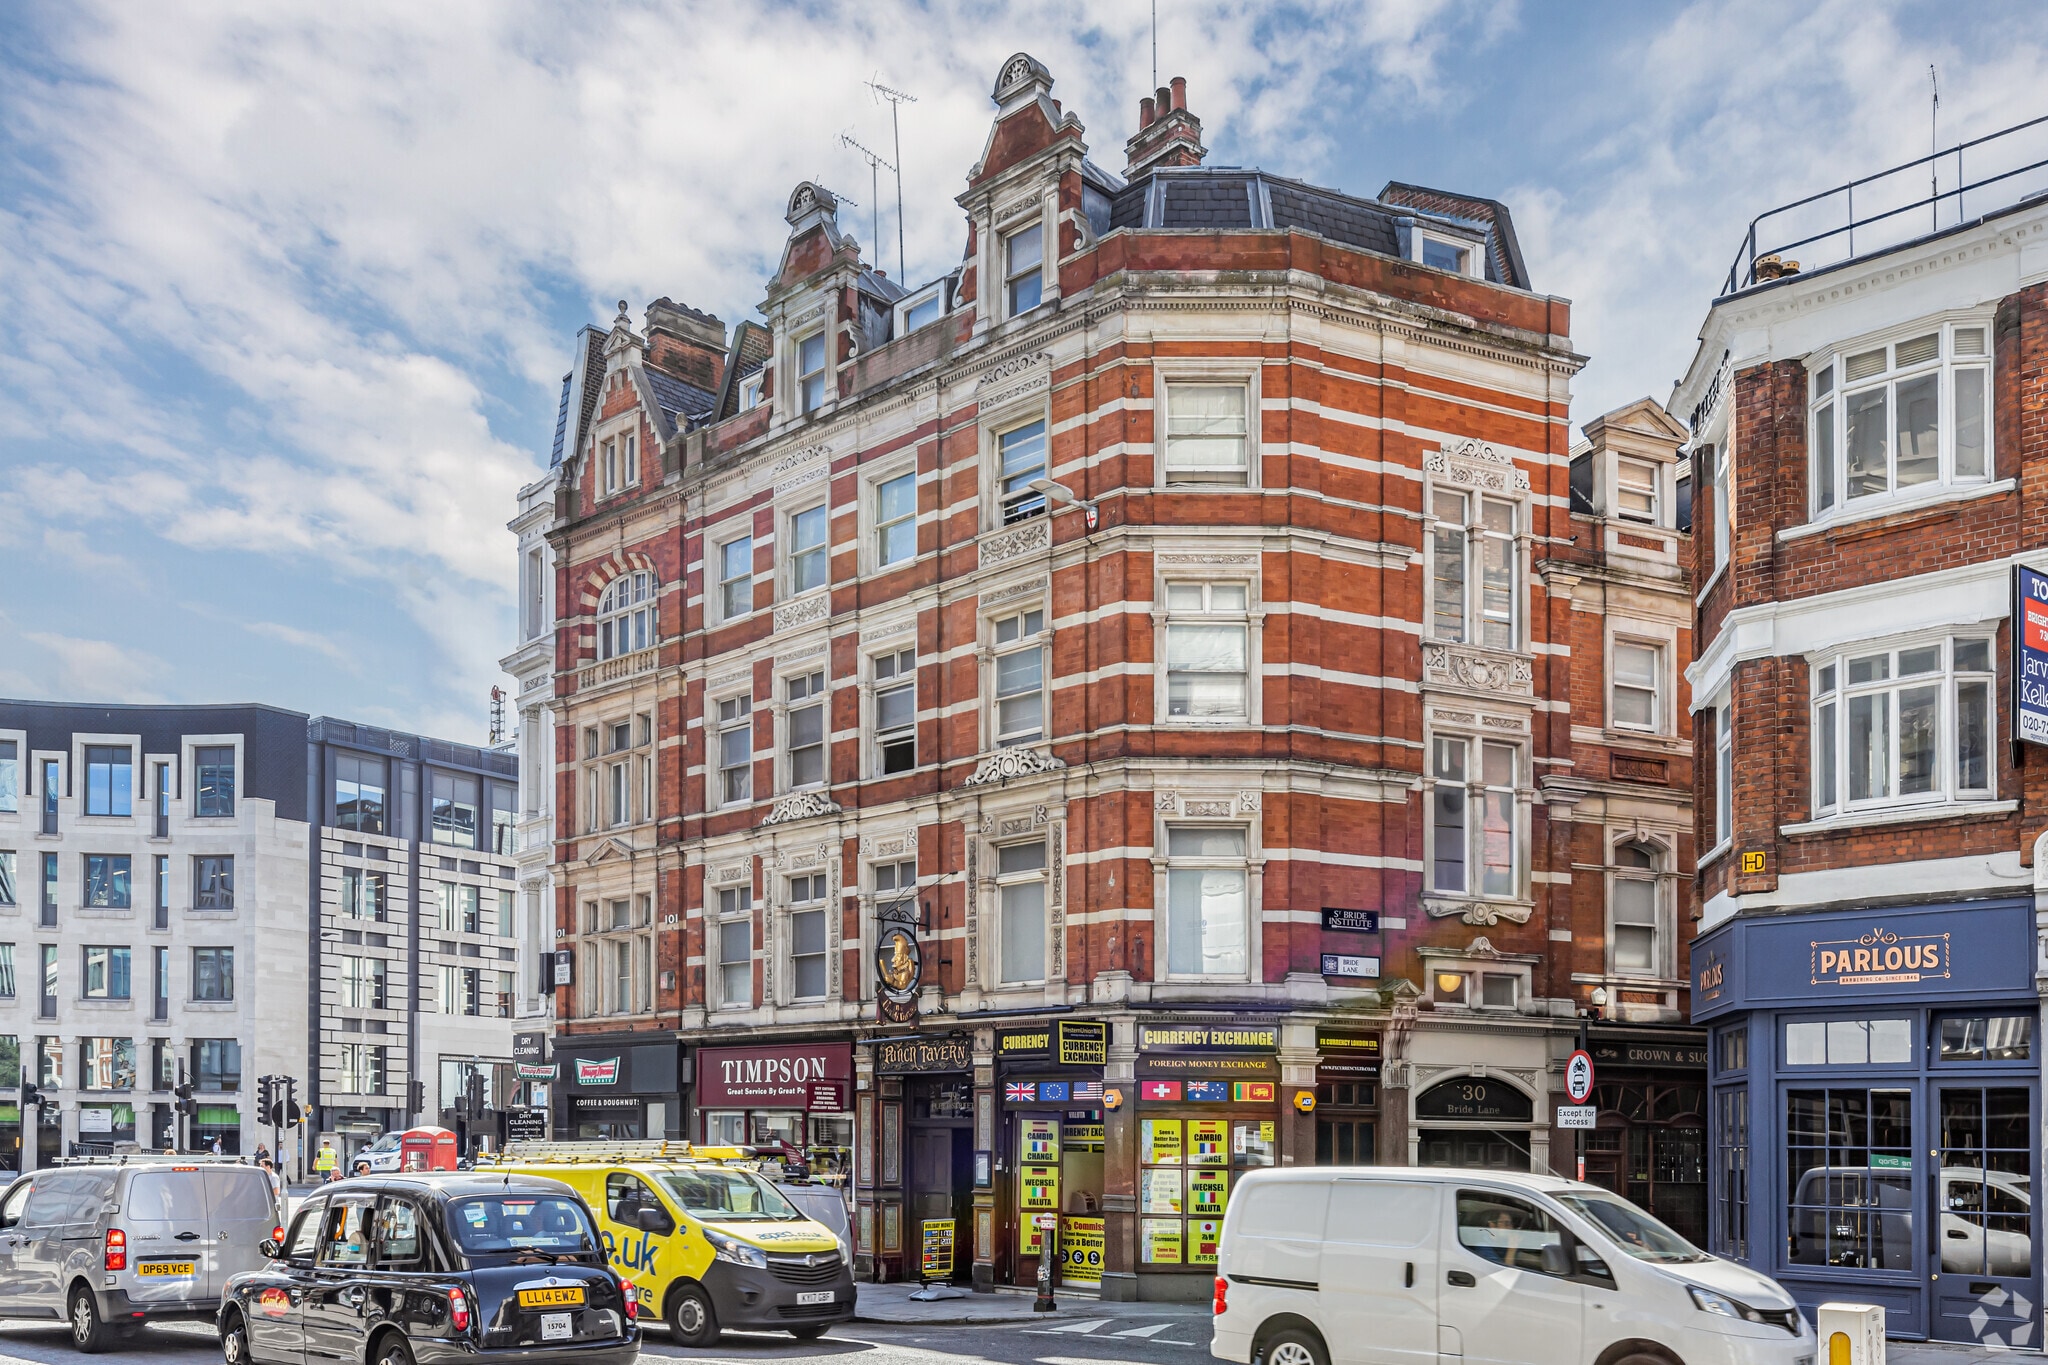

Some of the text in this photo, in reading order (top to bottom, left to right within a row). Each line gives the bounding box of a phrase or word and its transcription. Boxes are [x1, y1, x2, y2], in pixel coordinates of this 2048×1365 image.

[2031, 577, 2048, 600] TO
[2021, 649, 2048, 678] Jarv
[1343, 911, 1368, 920] BRIDE
[1328, 917, 1373, 928] INSTITUTE
[1820, 944, 1939, 974] PARLOUS
[1700, 964, 1723, 993] PARLOUS
[521, 1037, 533, 1045] DRY
[1002, 1034, 1050, 1050] CURRENCY
[1144, 1030, 1274, 1046] CURRENCY EXCHANGE
[1326, 1038, 1351, 1046] CURRENCY
[1062, 1040, 1105, 1052] CURRENCY
[514, 1047, 540, 1056] CLEANING
[1628, 1049, 1671, 1062] CROWN
[1675, 1051, 1684, 1062] &
[1063, 1051, 1104, 1063] EXCHANGE
[1149, 1060, 1267, 1069] FOREIGN MONEY EXCHANGE
[720, 1057, 827, 1084] TIMPSON
[727, 1086, 807, 1096] Great Service By Great Pe
[1462, 1085, 1486, 1101] 30
[1447, 1104, 1500, 1114] Bride Lane
[1558, 1109, 1595, 1118] Except for
[1027, 1132, 1054, 1140] CAMBIO
[1063, 1127, 1090, 1137] RRENCY
[1193, 1133, 1223, 1142] CAMBIO
[1027, 1152, 1054, 1161] CHANGE
[1194, 1154, 1223, 1163] CHANGE
[1024, 1178, 1055, 1187] WECHSEL
[1191, 1183, 1225, 1192] WECHSEL
[1027, 1198, 1052, 1206] VALUTA
[1195, 1204, 1222, 1212] VALUTA
[1063, 1238, 1075, 1246] ays
[1081, 1238, 1104, 1248] Better
[143, 1264, 190, 1274] DP69 VCE
[261, 1293, 288, 1310] ComCab
[526, 1290, 577, 1304] LL14 EWZ
[547, 1322, 567, 1330] 15704
